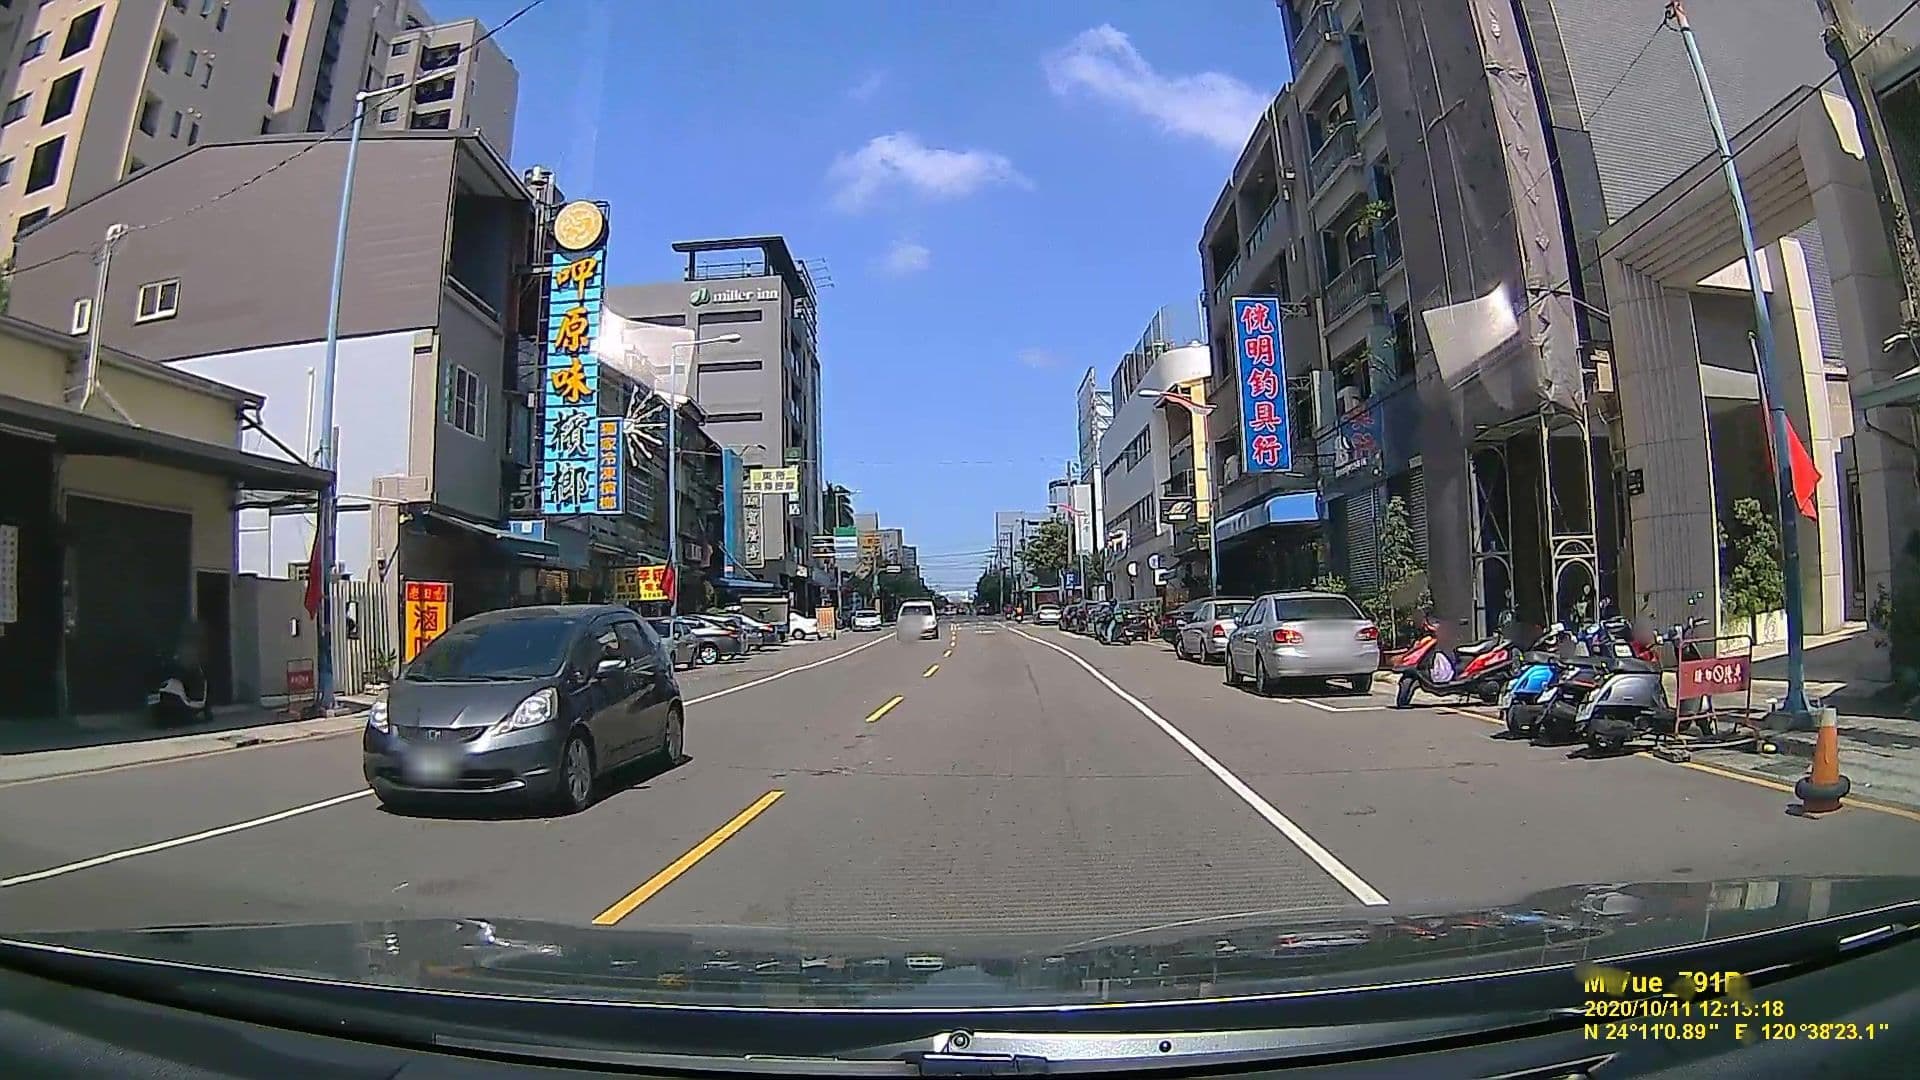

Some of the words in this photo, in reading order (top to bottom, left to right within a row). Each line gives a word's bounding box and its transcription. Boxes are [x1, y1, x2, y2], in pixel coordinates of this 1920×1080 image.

[713, 289, 755, 302] miller
[757, 287, 778, 300] inn
[552, 257, 598, 506] 呷原味檳榔
